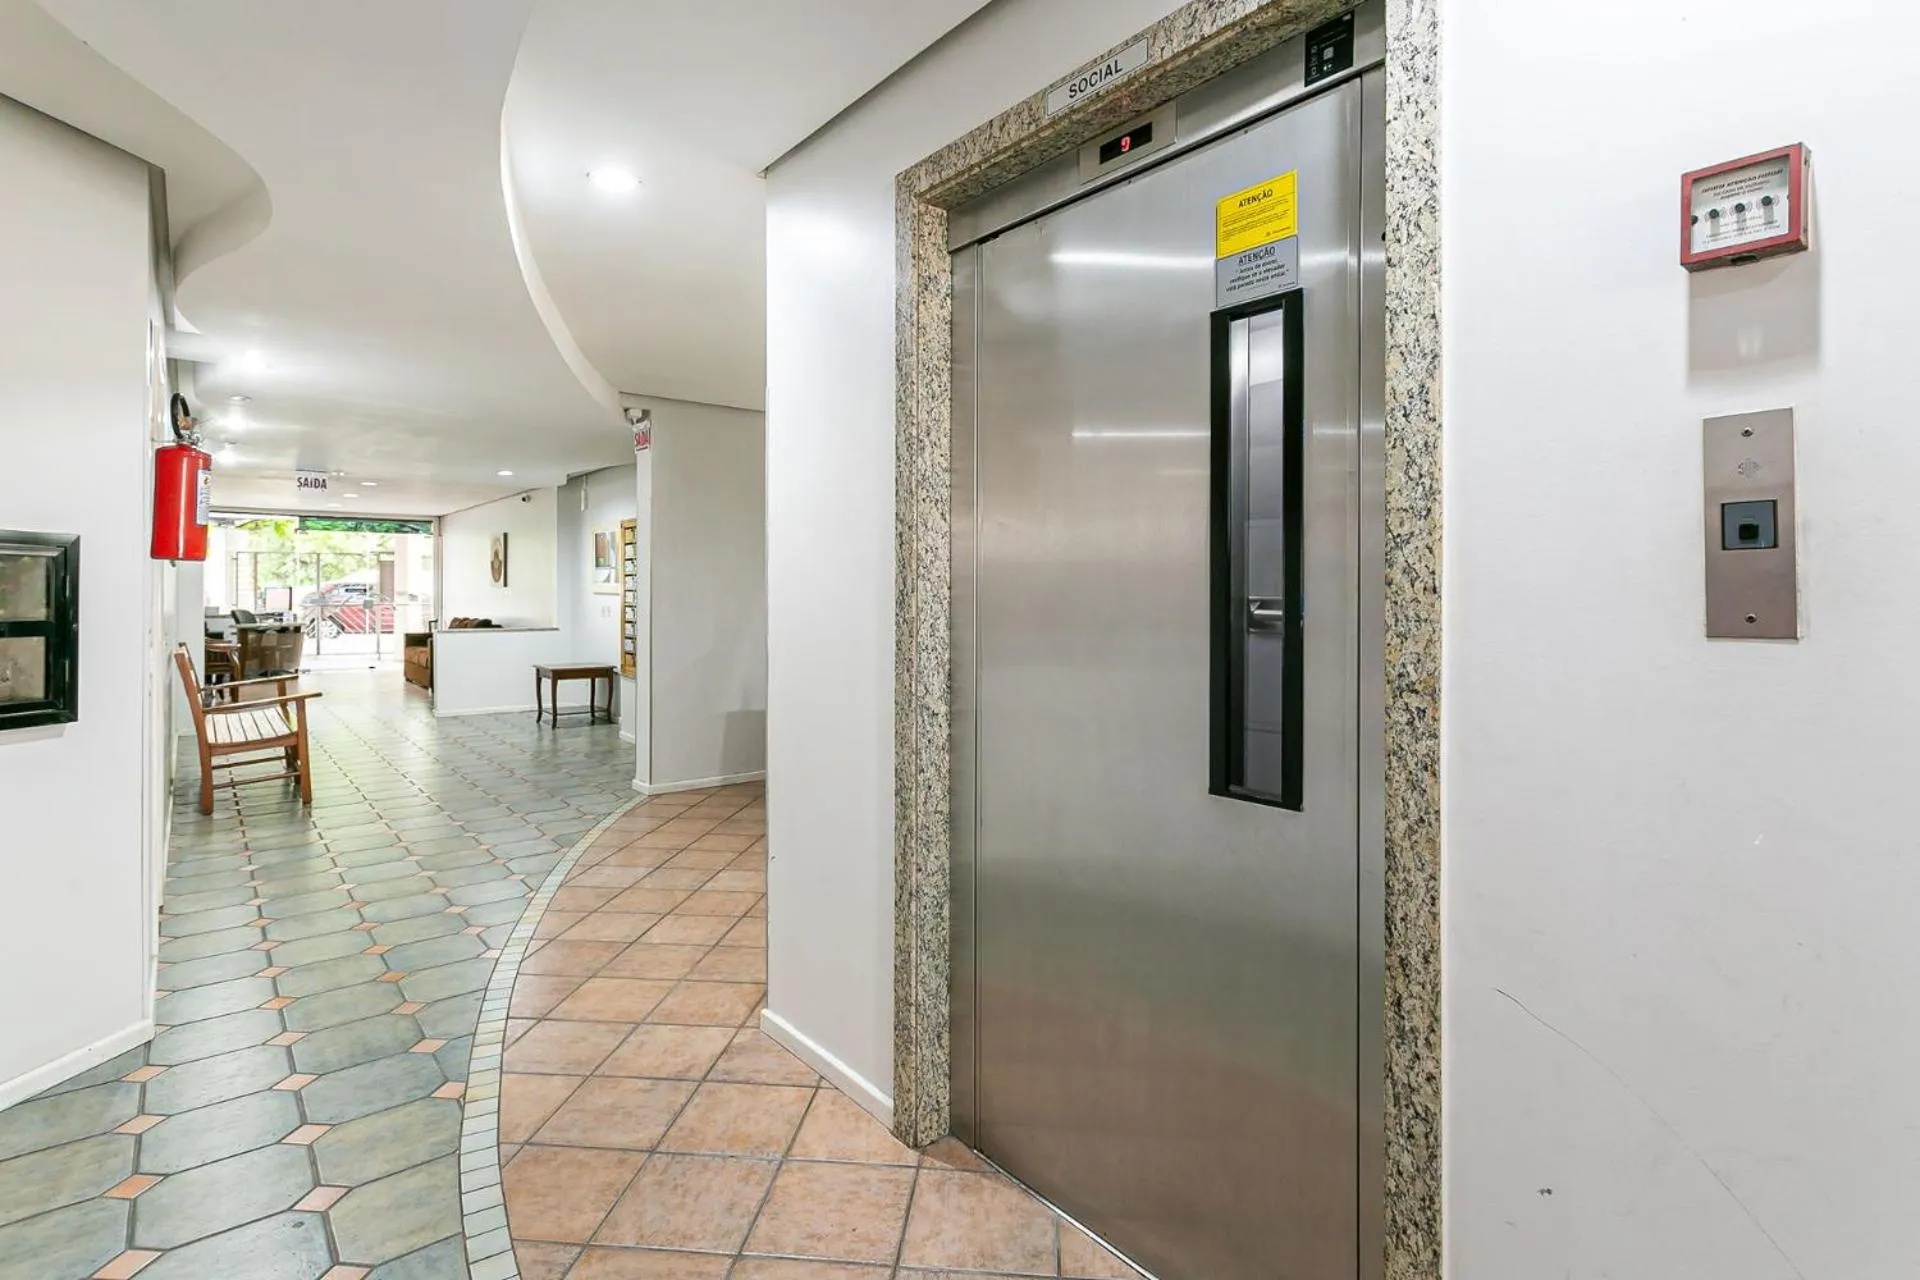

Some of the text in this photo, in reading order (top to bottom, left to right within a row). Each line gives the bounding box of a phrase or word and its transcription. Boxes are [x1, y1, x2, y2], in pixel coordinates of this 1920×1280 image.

[1068, 60, 1123, 98] SOCIAL
[1238, 189, 1273, 208] ATENÇÃO
[1239, 246, 1276, 264] ATENÇÃO
